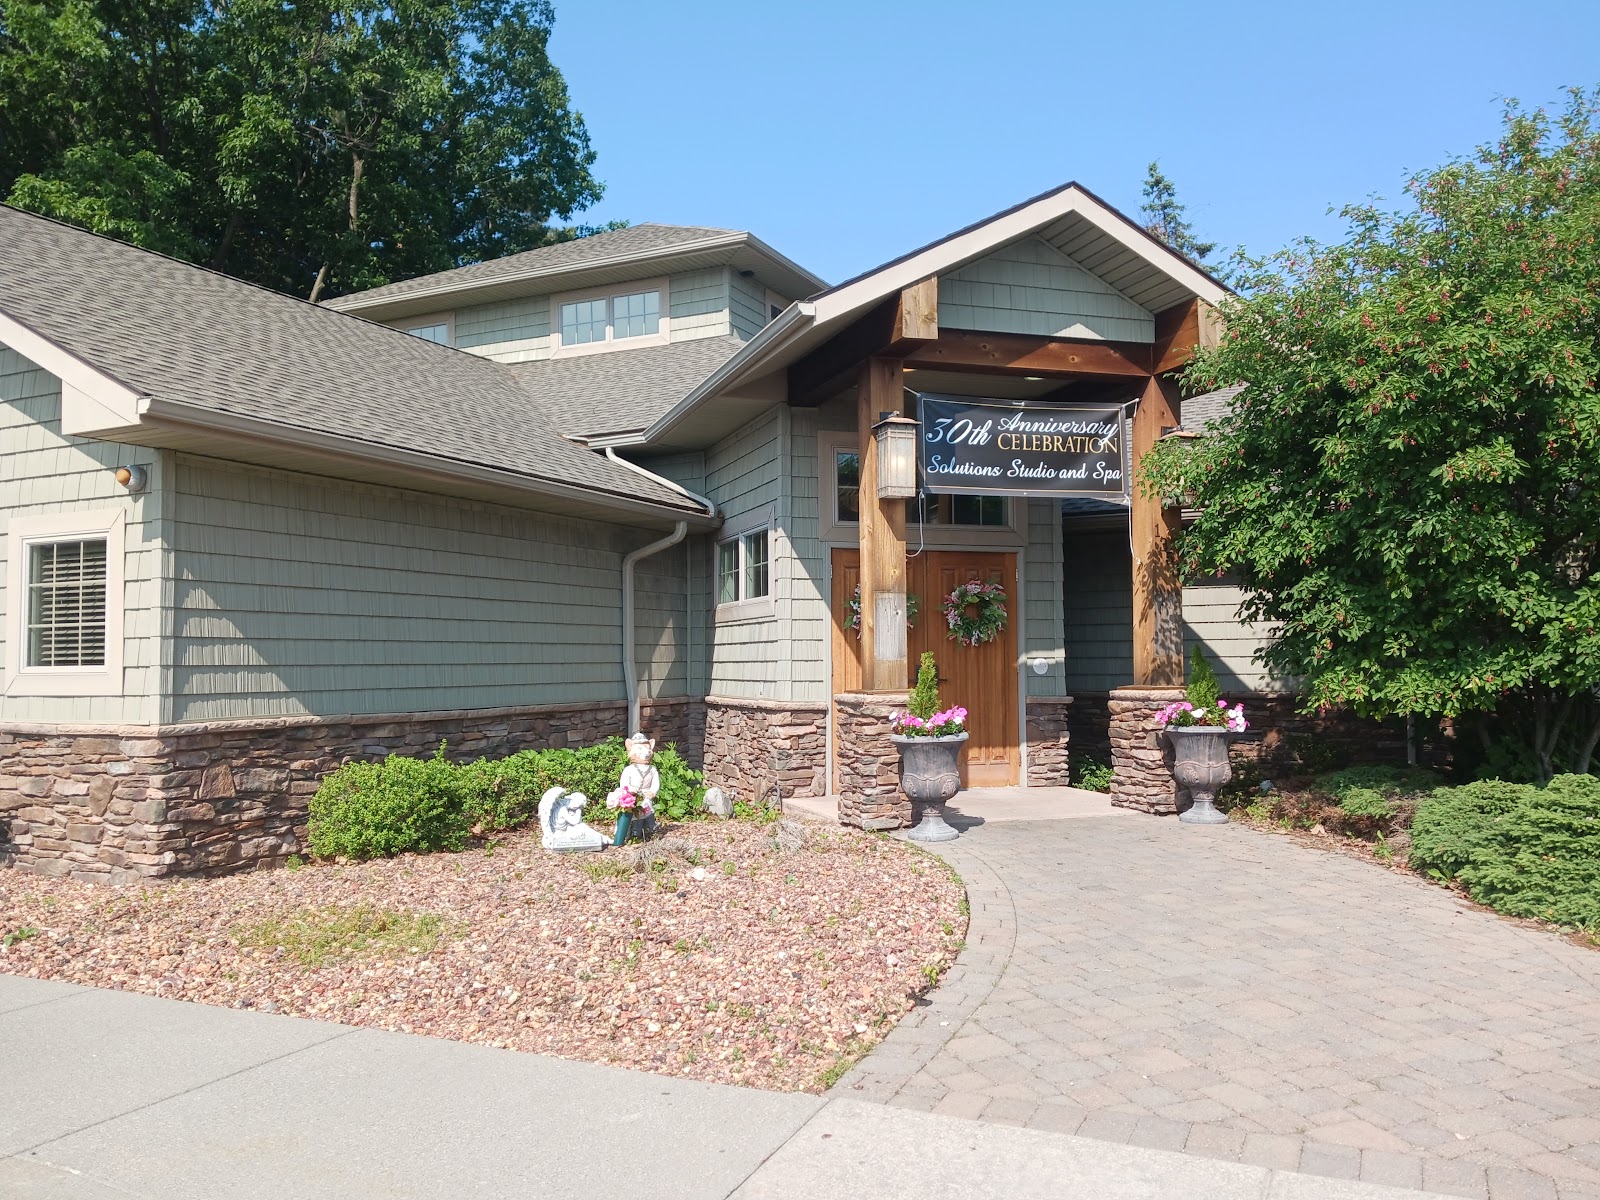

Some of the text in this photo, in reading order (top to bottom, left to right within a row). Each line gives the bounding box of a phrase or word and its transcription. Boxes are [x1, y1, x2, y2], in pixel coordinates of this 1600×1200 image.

[925, 418, 993, 446] 30th
[997, 411, 1119, 446] Anniversary
[997, 433, 1118, 454] CELEBRATION
[927, 454, 1121, 485] Solutions Studio and Spa
